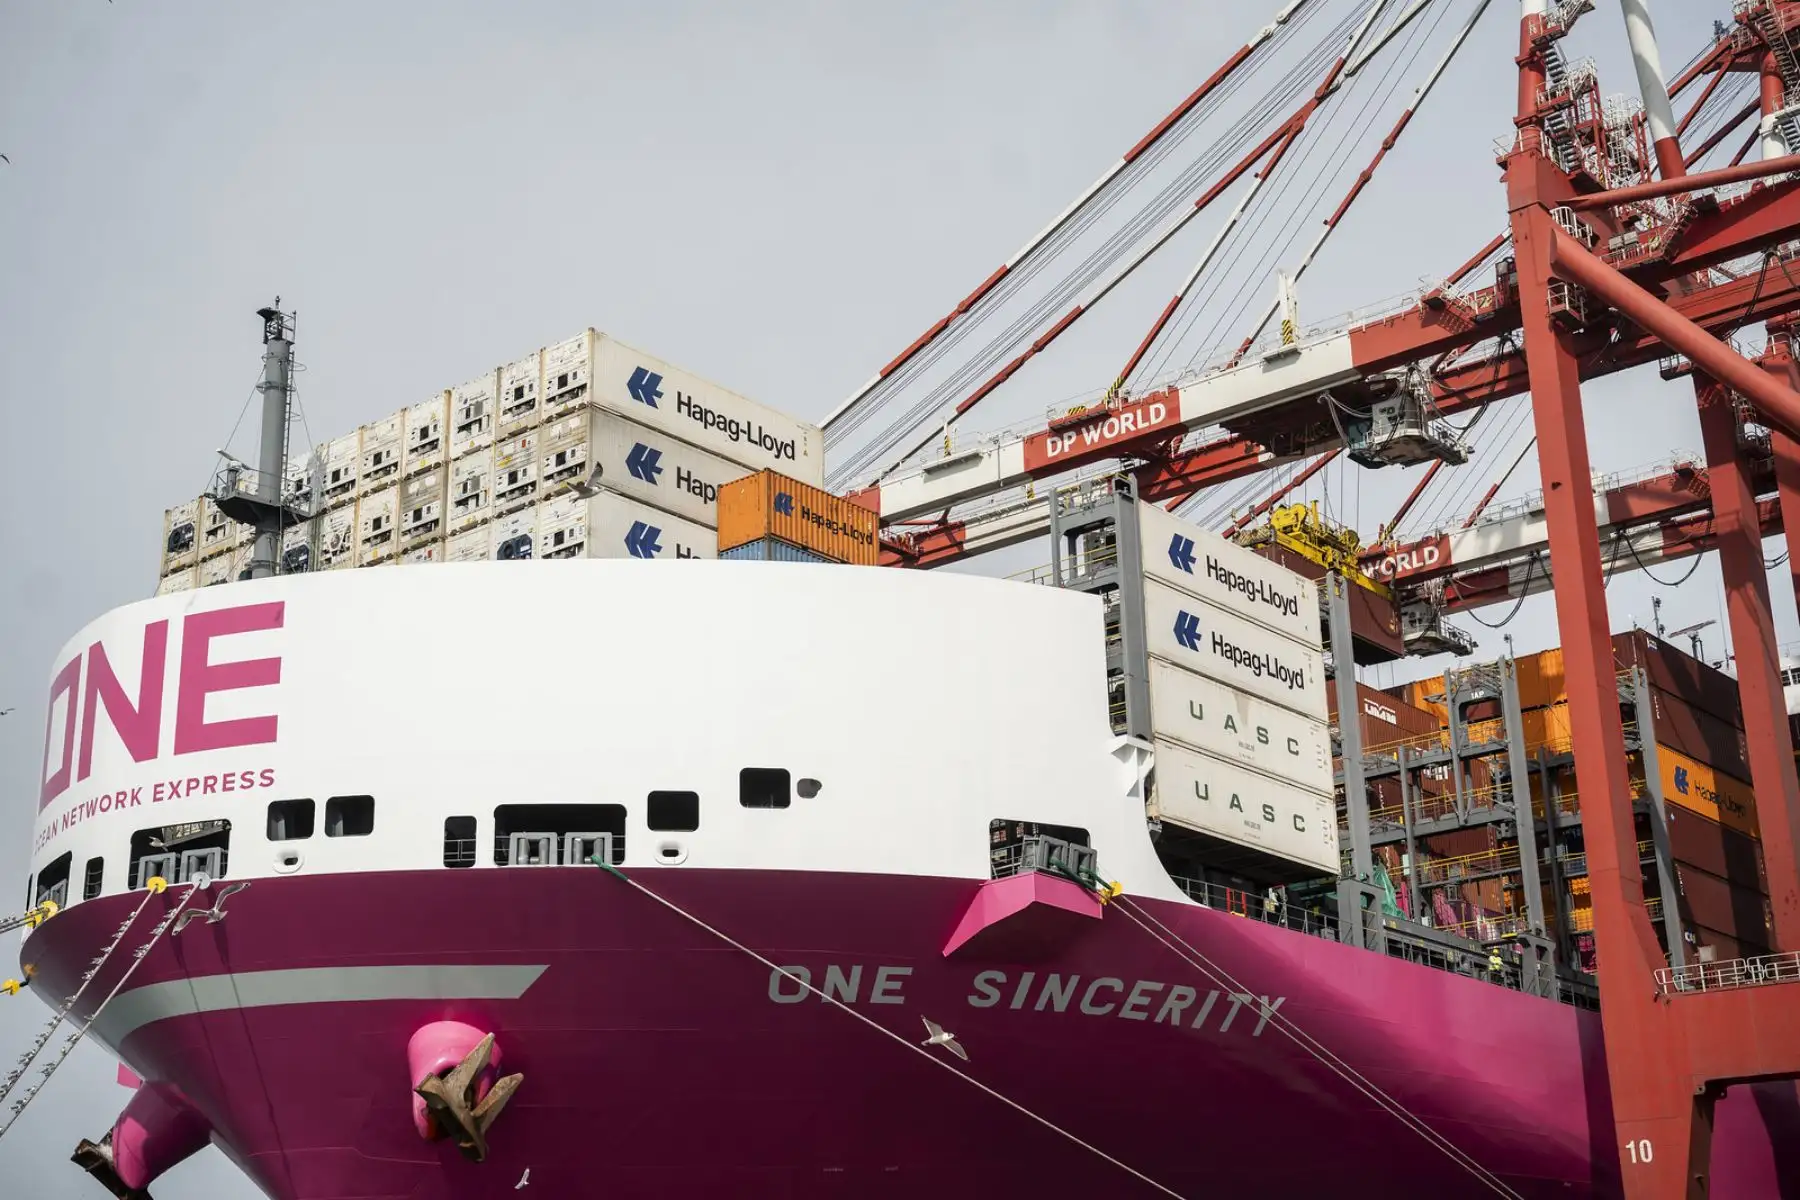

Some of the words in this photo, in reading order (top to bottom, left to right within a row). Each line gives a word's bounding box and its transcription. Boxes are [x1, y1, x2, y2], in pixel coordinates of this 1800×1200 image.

[676, 391, 796, 461] Hapag-Lloyd
[1046, 427, 1076, 457] DP
[1083, 402, 1167, 444] WORLD
[676, 465, 717, 504] Hap
[801, 505, 873, 545] Hapag-Lloyd
[1205, 553, 1299, 617] Hapag-Lloyd
[1360, 545, 1440, 579] WORLD
[1211, 630, 1305, 690] Hapag-Lloyd
[40, 601, 285, 816] ONE
[62, 786, 143, 833] NETWORK
[152, 768, 275, 802] EXPRESS
[767, 964, 914, 1005] ONE
[967, 970, 1287, 1037] SINCERITY
[1625, 1139, 1654, 1164] 10
